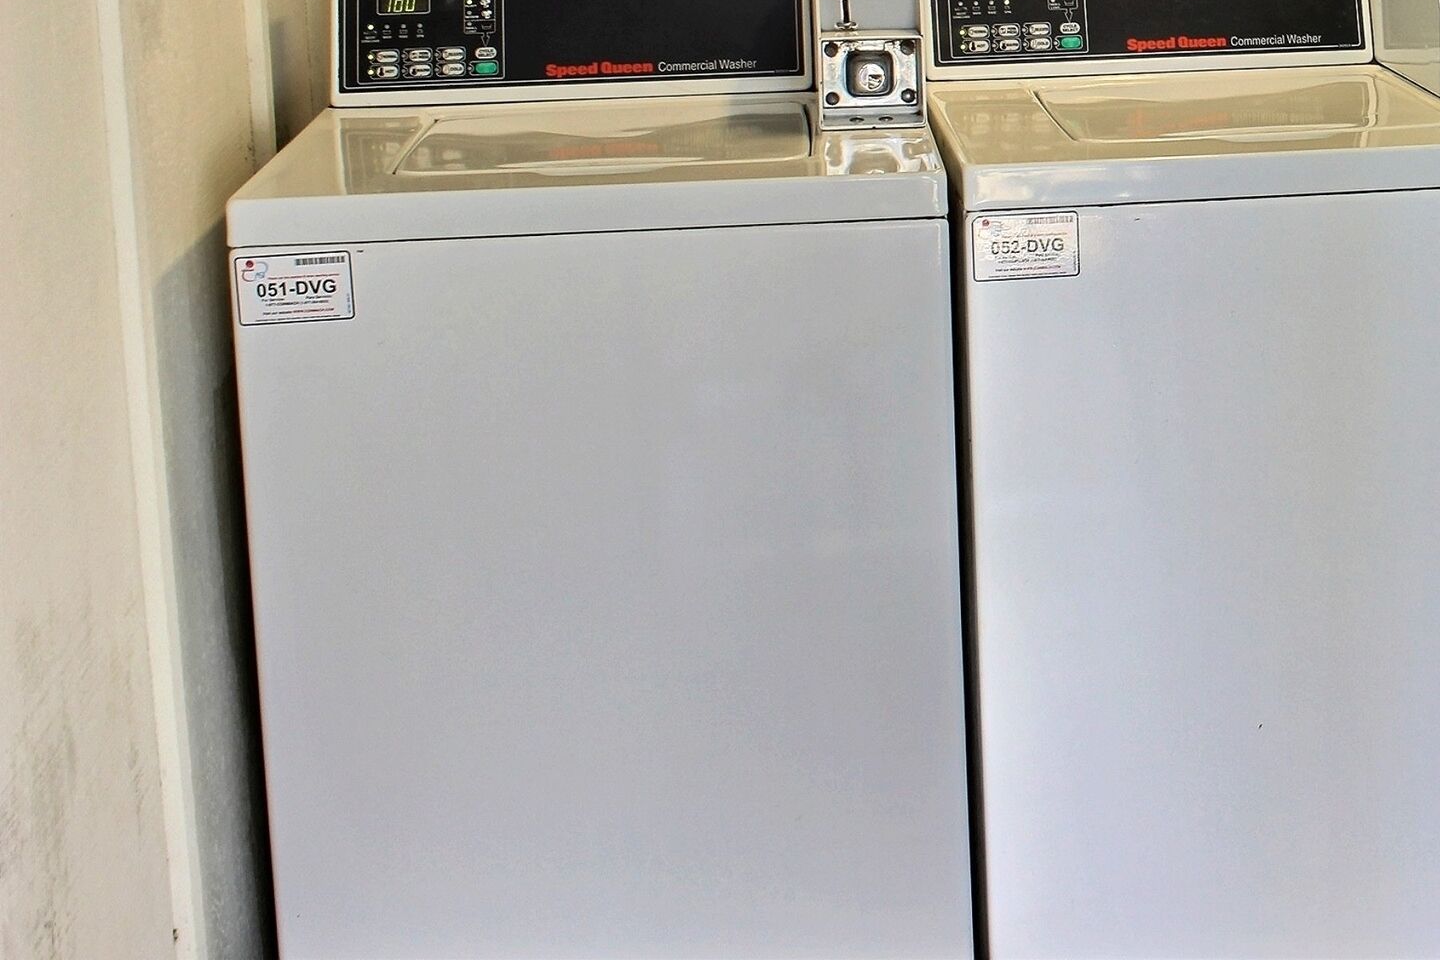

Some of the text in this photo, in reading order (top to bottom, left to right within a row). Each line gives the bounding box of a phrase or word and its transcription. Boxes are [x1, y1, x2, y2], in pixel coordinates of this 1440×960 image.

[1127, 33, 1322, 52] Speed Queen Commercial Washer
[545, 59, 757, 78] Speed Queen Commercial Washer
[991, 238, 1064, 255] 052-DVG
[256, 278, 336, 298] 051-DVG
